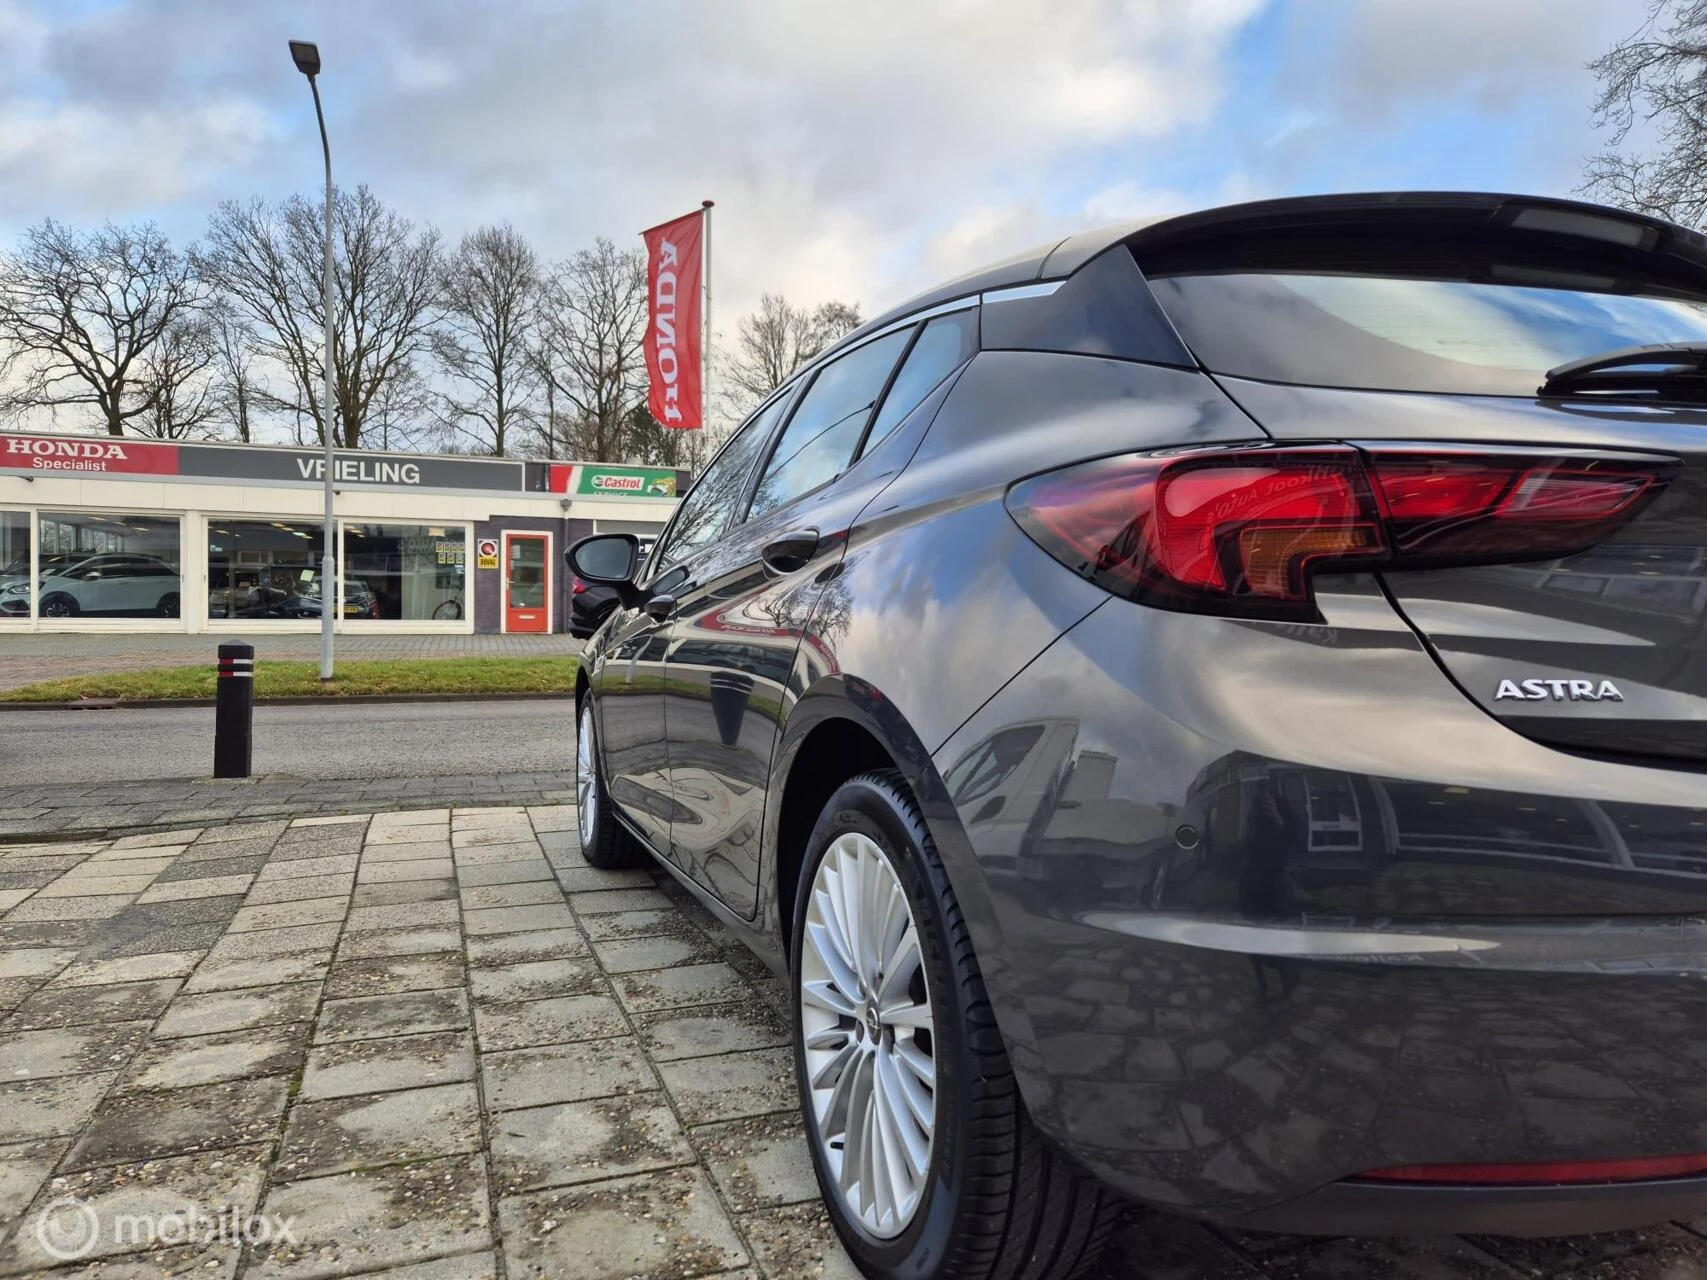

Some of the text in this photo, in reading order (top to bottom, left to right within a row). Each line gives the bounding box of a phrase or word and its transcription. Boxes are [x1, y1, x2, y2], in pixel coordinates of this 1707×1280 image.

[6, 438, 128, 460] HONDA
[32, 456, 107, 472] Specialist
[604, 476, 641, 489] Castrol
[1494, 678, 1624, 701] ASTRA
